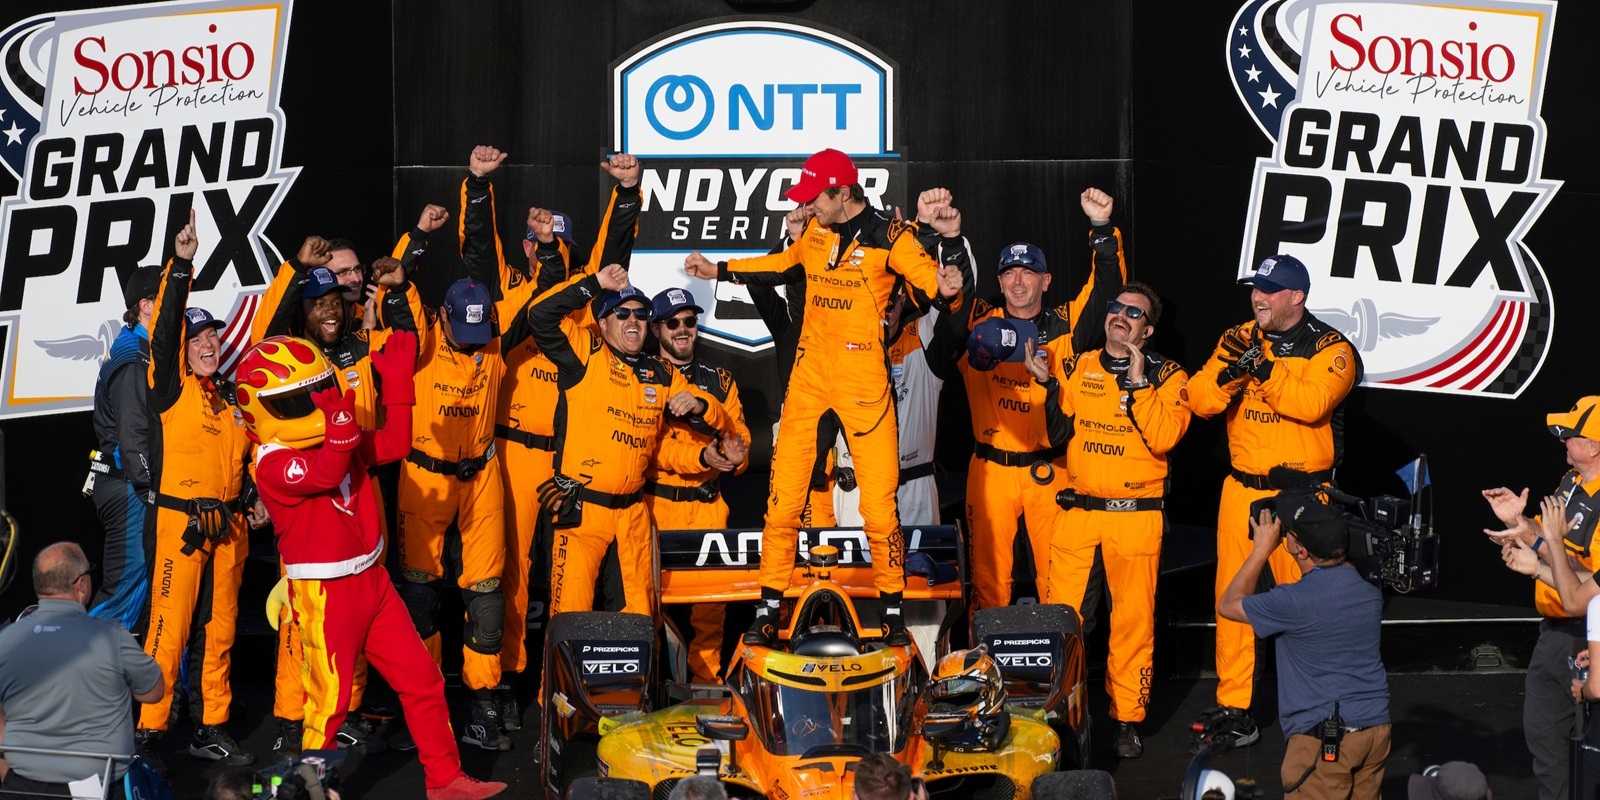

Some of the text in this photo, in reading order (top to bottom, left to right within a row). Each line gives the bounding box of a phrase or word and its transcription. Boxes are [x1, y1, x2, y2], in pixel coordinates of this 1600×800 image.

[73, 24, 255, 97] Sonsio
[1329, 13, 1516, 83] Sonsio
[1316, 66, 1525, 106] Vehicle Protection
[60, 78, 264, 127] Vehicle Protection
[728, 83, 862, 131] NTT
[29, 117, 274, 201] GRAND
[1284, 107, 1535, 185] GRAND
[639, 167, 891, 212] NDYCR
[0, 183, 280, 310] PRIX
[1251, 171, 1540, 293] PRIX
[807, 273, 862, 288] REYNOLDS
[811, 295, 853, 310] ARROW
[438, 404, 480, 418] ARROW
[607, 405, 656, 425] REYNOLDS
[1079, 418, 1134, 433] REYNOLDS
[611, 429, 648, 449] ARROW
[1082, 441, 1126, 457] ARROW
[161, 558, 174, 598] ARROW
[1004, 638, 1051, 646] PRIZEPICKS
[584, 662, 639, 674] VELO
[817, 663, 863, 672] VELO
[997, 656, 1052, 667] VELO
